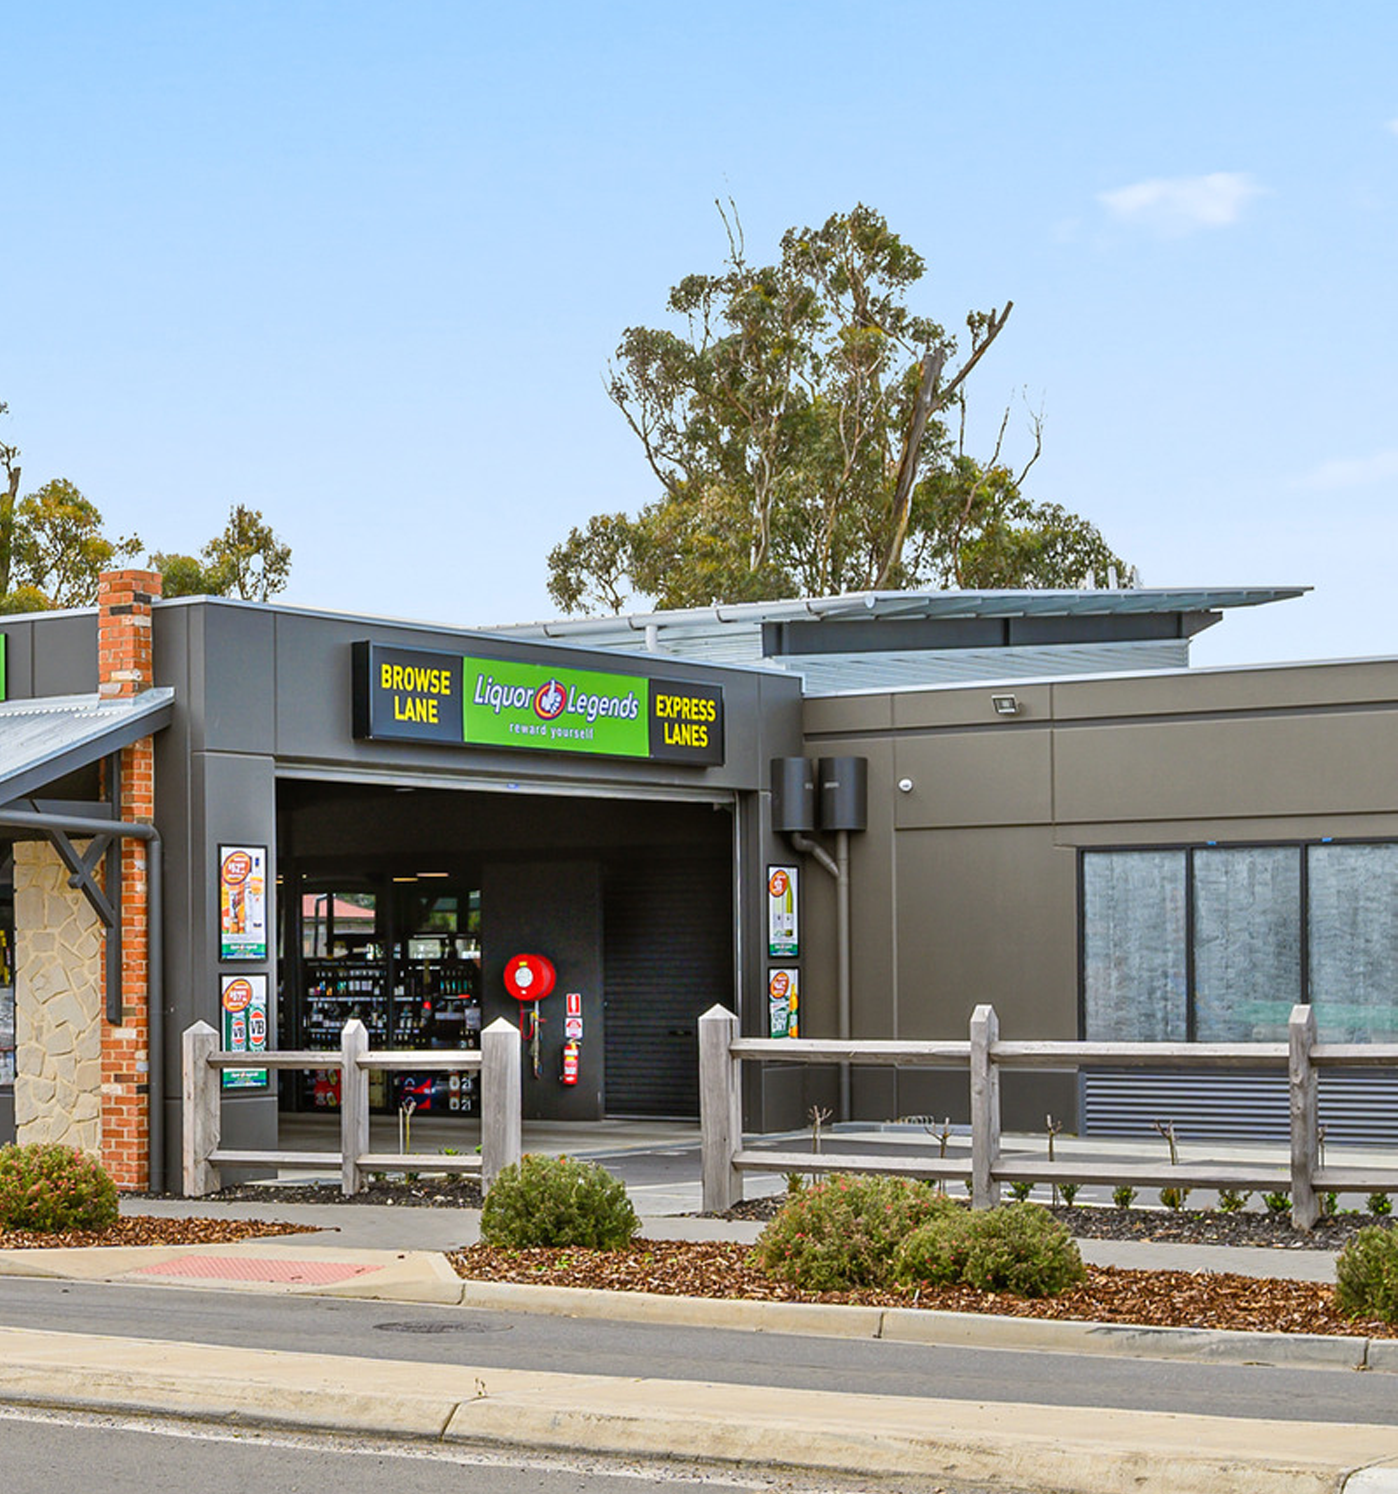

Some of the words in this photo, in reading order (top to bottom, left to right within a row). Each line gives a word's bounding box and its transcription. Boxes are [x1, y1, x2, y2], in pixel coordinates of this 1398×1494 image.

[381, 664, 451, 695] BROWSE
[394, 695, 438, 724] LANE
[474, 674, 534, 714] Liquor
[567, 685, 638, 723] Legends
[656, 694, 716, 722] EXPRESS
[509, 722, 547, 737] reward
[551, 727, 594, 740] yourself
[664, 724, 708, 747] LANES
[251, 1020, 264, 1035] VB
